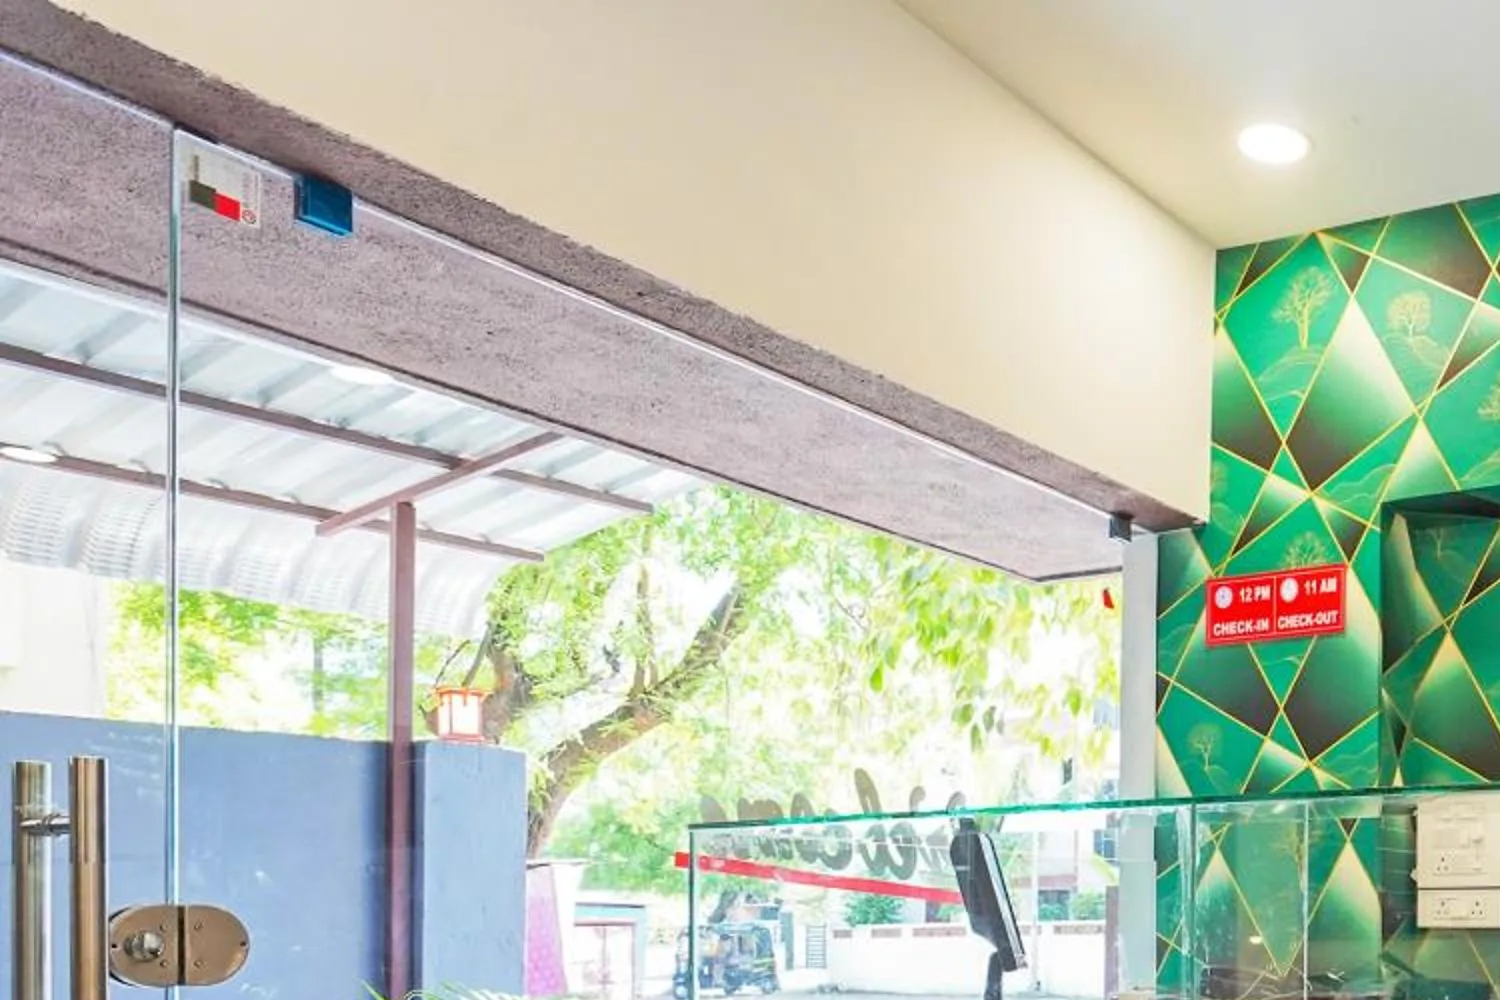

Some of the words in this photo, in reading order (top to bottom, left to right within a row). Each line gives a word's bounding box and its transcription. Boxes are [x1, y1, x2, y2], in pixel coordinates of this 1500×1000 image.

[1239, 586, 1253, 603] 12
[1254, 585, 1271, 602] PM
[1304, 580, 1317, 596] 11
[1319, 577, 1337, 593] AM
[1213, 618, 1269, 637] CHECK-IN
[1277, 610, 1338, 630] CHECK-OUT
